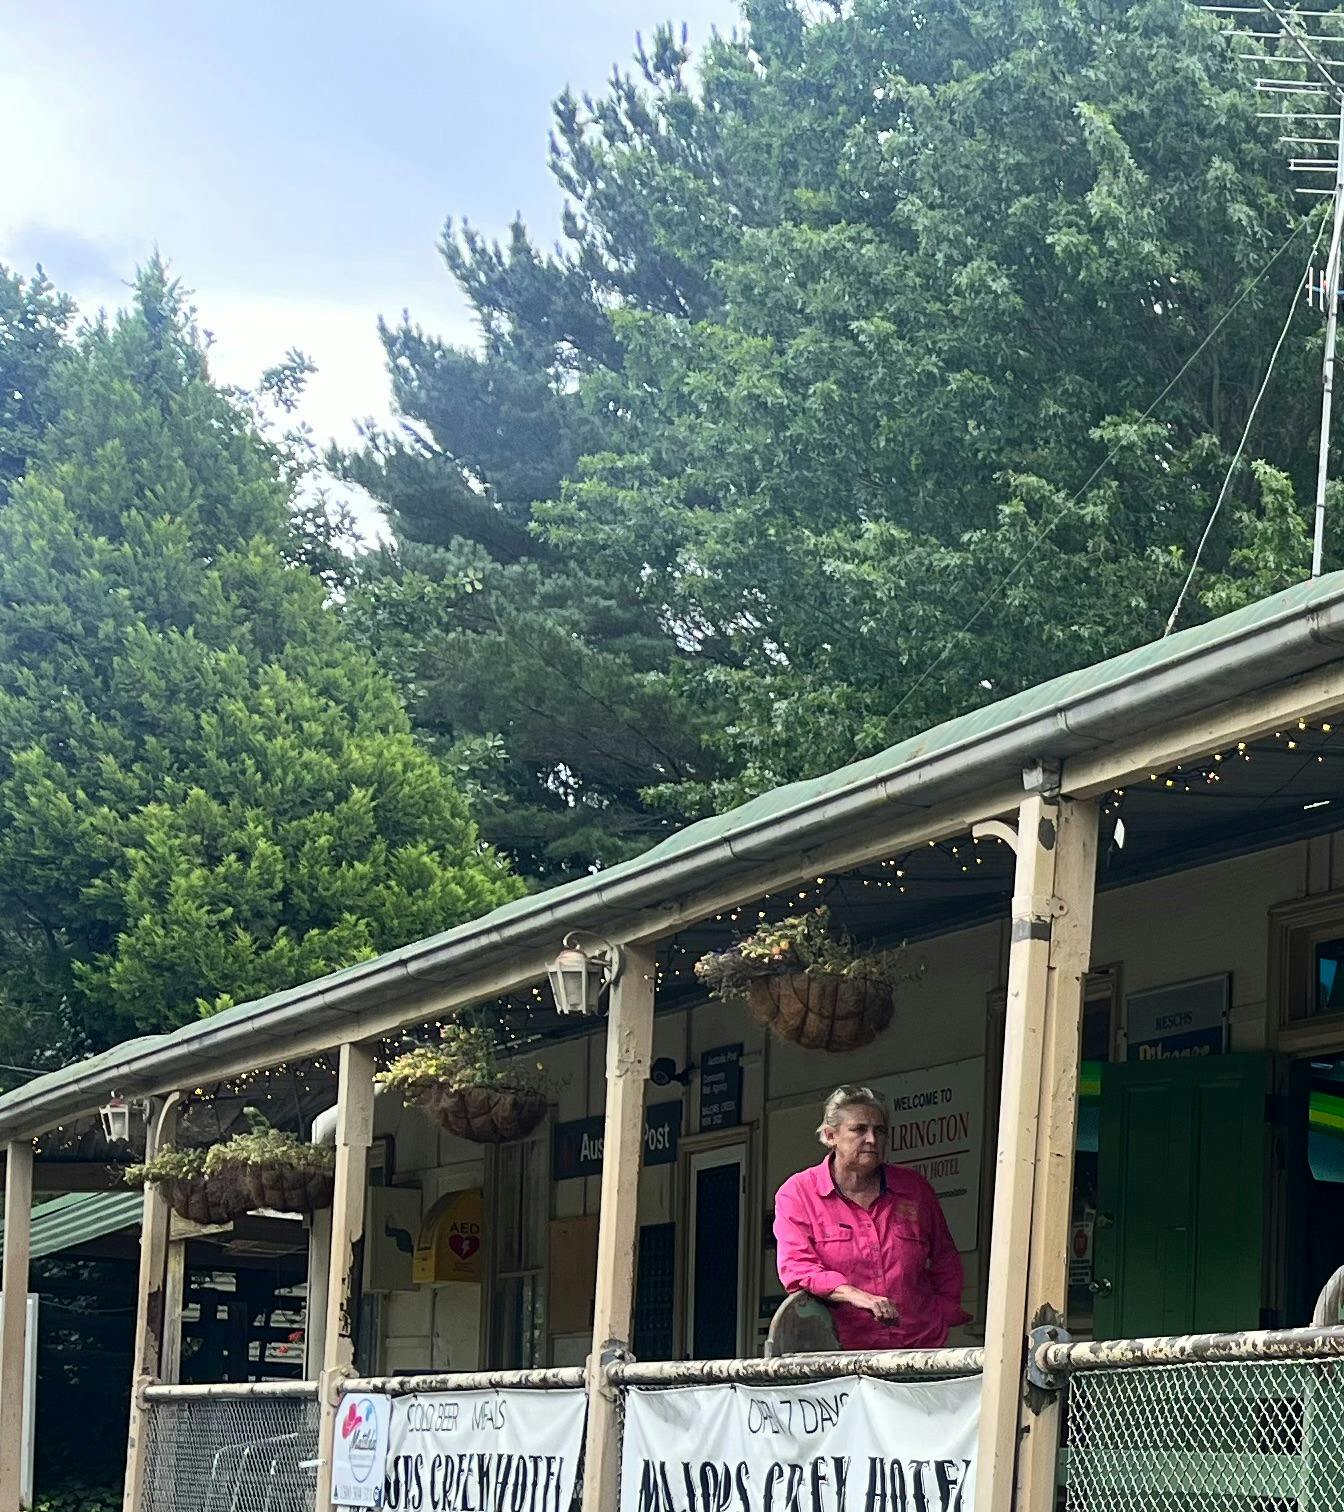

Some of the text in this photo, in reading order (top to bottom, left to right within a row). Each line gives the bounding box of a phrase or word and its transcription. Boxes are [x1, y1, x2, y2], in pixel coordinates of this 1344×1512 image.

[894, 1088, 952, 1111] WELCOME TO
[890, 1112, 970, 1152] LRINGTON
[930, 1158, 960, 1179] HOTEL
[449, 1222, 480, 1234] AED
